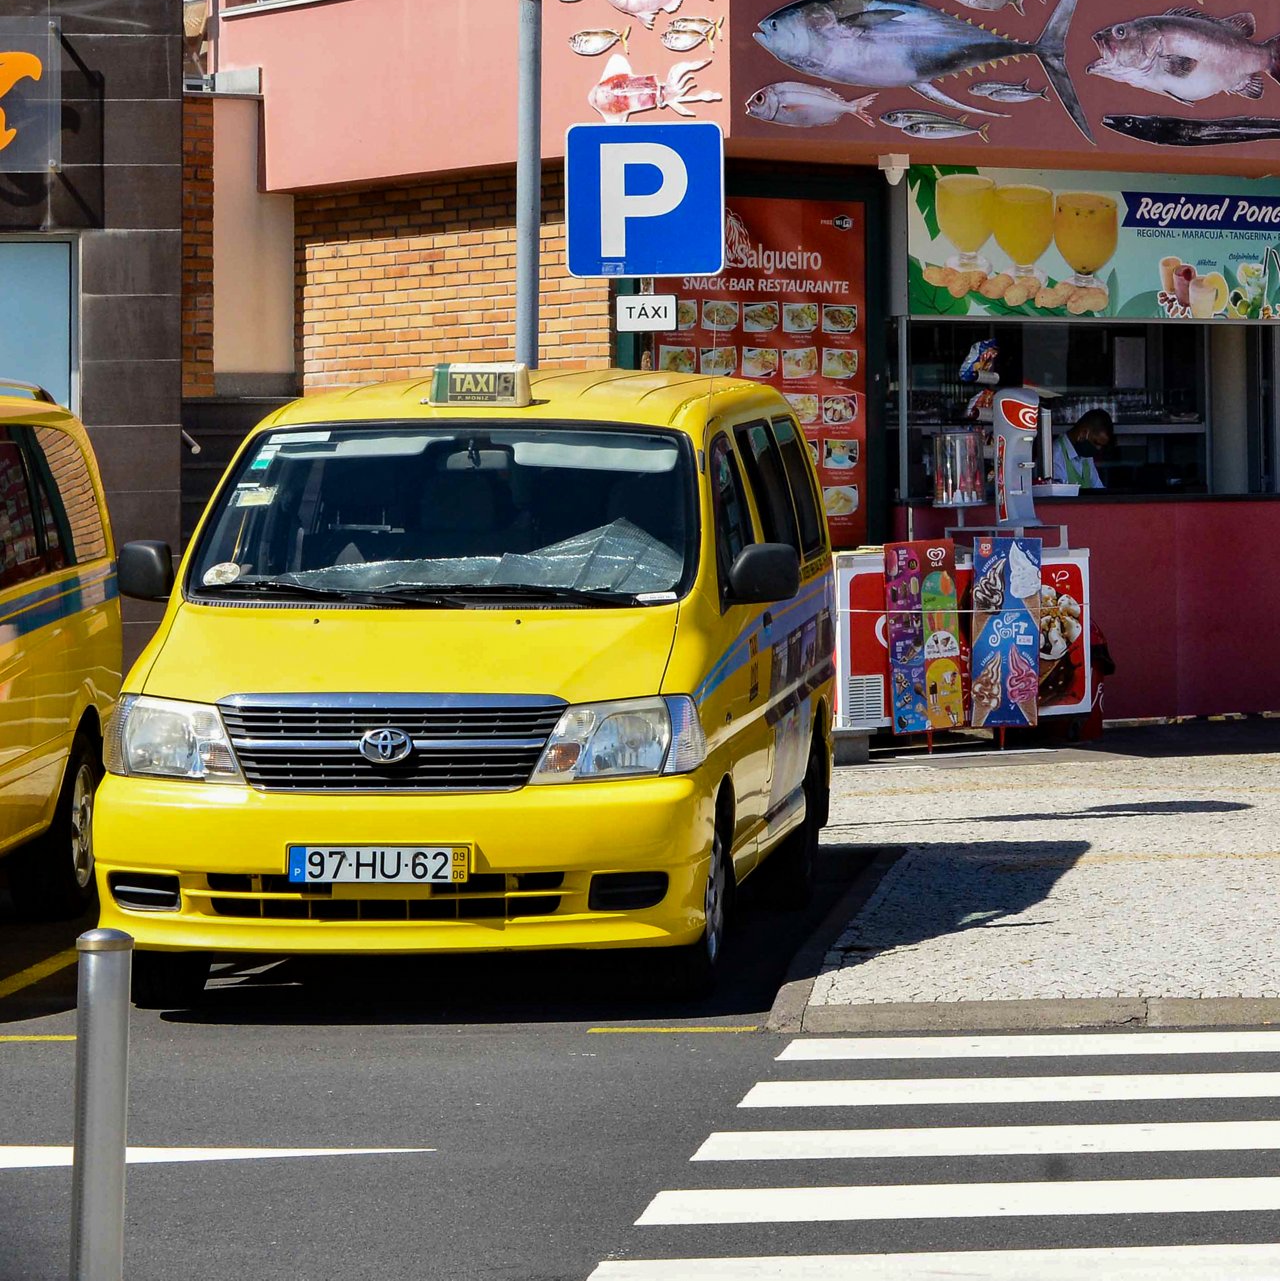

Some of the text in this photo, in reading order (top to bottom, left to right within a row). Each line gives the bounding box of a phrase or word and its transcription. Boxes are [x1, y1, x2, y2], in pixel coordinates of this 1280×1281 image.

[599, 142, 689, 258] P
[1136, 197, 1230, 226] Regional
[1136, 229, 1176, 238] REGIONAL
[1182, 228, 1224, 240] MARACUJÁ
[1229, 231, 1272, 241] TANGERINA
[736, 243, 822, 274] Salgueiro
[683, 277, 849, 294] SNACK-BAR RESTAURANTE
[626, 302, 669, 321] TÁXI
[452, 373, 495, 393] TAXI
[453, 852, 465, 861] 09
[295, 868, 301, 876] P
[453, 870, 465, 879] 06
